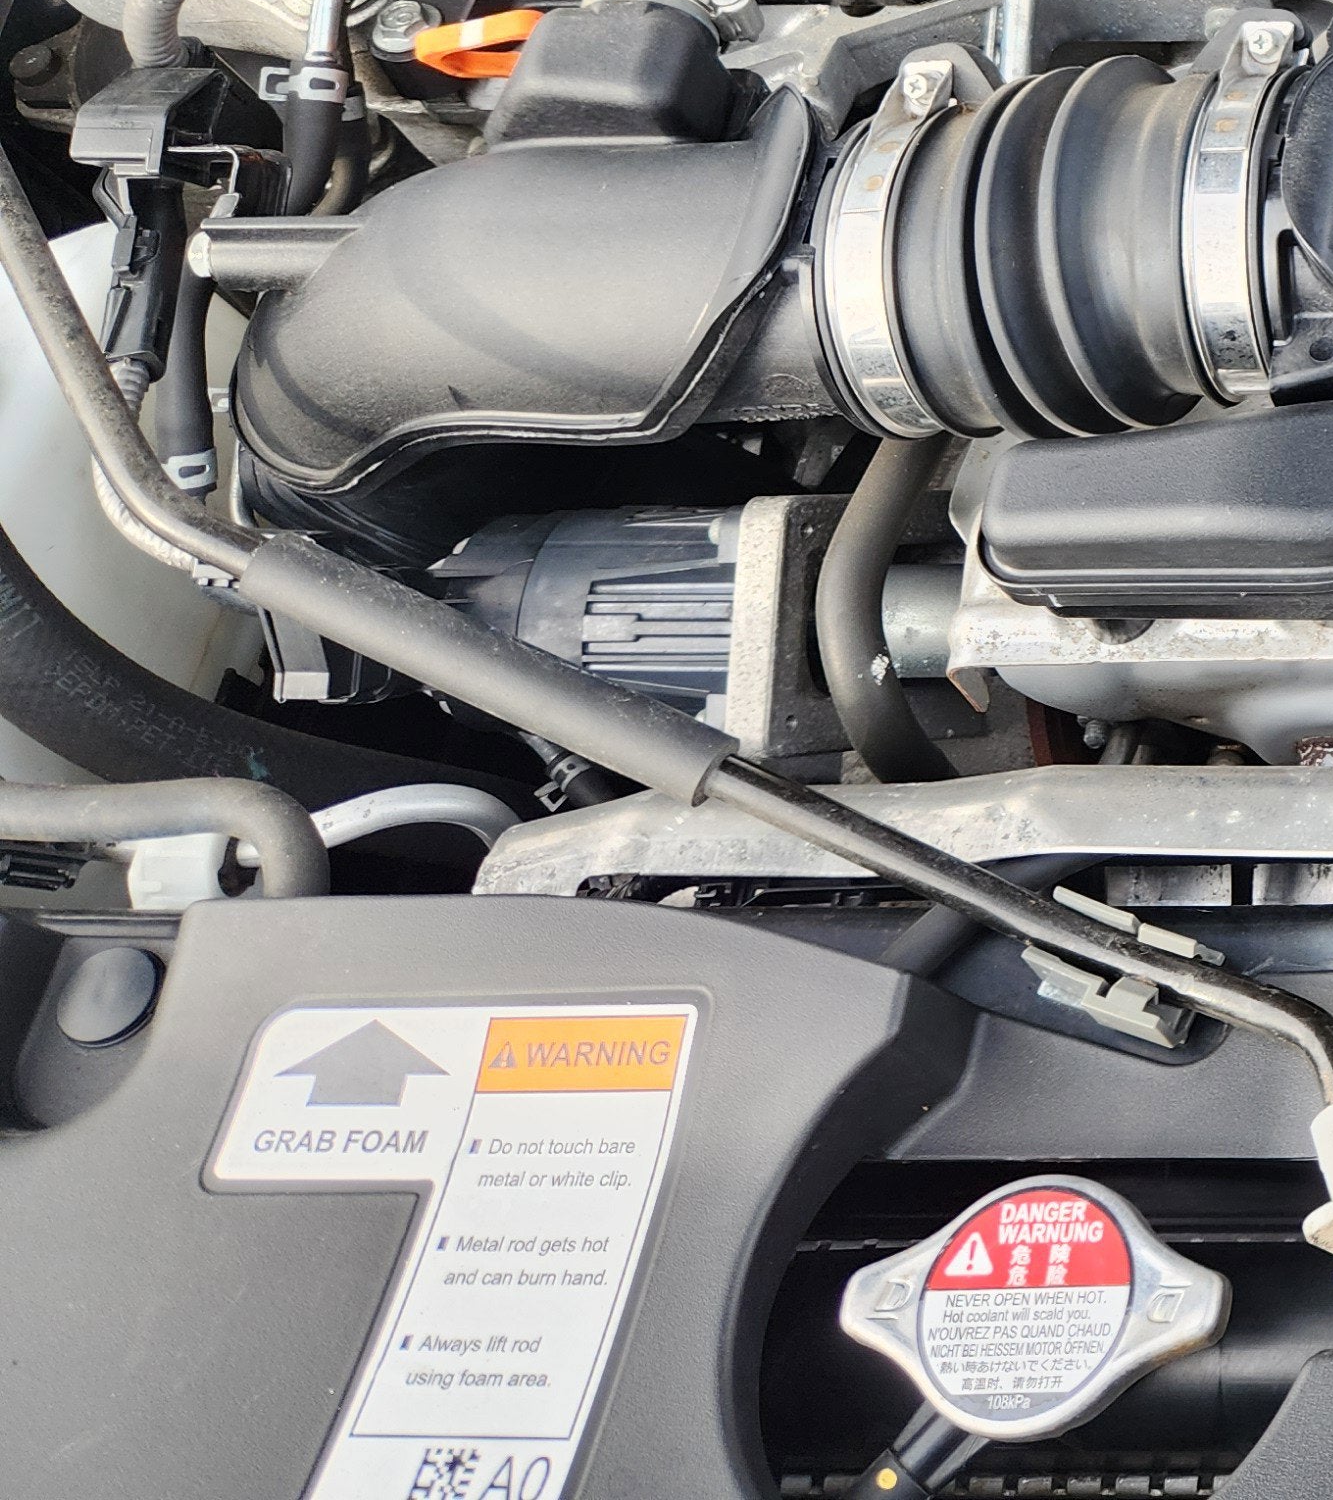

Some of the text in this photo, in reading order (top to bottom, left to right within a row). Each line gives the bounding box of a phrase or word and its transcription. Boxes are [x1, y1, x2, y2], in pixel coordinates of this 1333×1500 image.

[526, 1040, 671, 1068] WARNING
[253, 1129, 430, 1153] GRAB FOAM
[488, 1138, 636, 1155] Do not touch bare
[477, 1170, 632, 1190] metal or white clip.
[1001, 1202, 1088, 1224] DANGER
[998, 1221, 1104, 1244] WARNUNG
[455, 1236, 610, 1256] Metal rod gets hot
[443, 1269, 609, 1285] and can burn hand.
[945, 1290, 1107, 1308] NEVER OPEN WHEN HOT.
[943, 1307, 1091, 1324] Hot coolant will scald you.
[927, 1326, 990, 1342] N'OUVREZ
[993, 1325, 1018, 1340] PAS
[1020, 1324, 1064, 1339] QUAND
[417, 1335, 543, 1356] Always lift rod
[930, 1344, 960, 1359] NICHT
[962, 1343, 979, 1358] BEI
[979, 1342, 1024, 1357] HEISSEM
[1026, 1341, 1062, 1356] MOTOR
[405, 1369, 552, 1389] using foam area.
[987, 1394, 1032, 1410] 108kPa
[477, 1455, 551, 1500] A0
